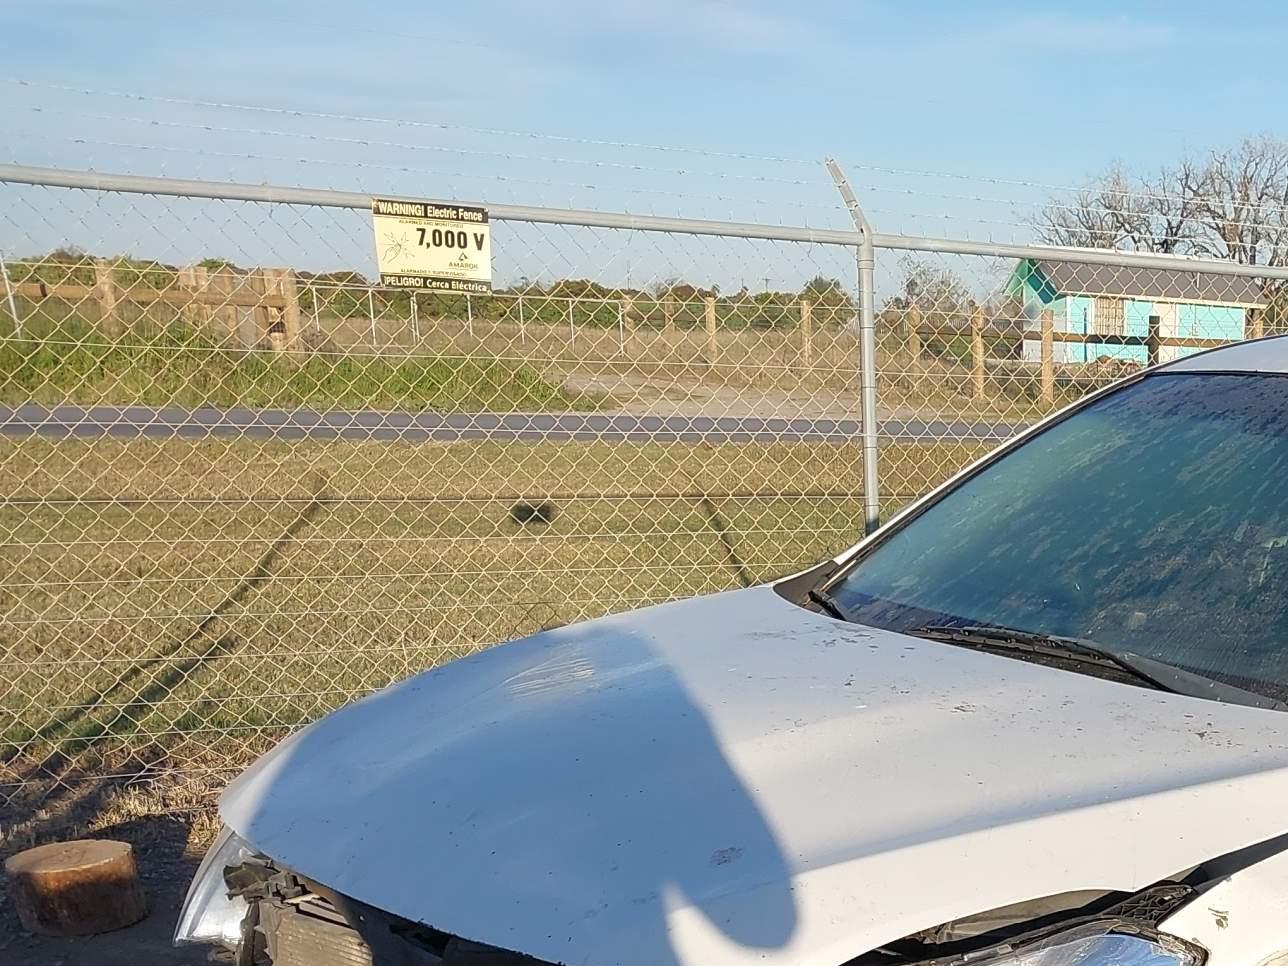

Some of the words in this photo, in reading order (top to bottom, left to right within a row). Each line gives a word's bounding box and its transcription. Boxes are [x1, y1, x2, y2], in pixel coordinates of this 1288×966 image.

[378, 201, 425, 217] WARNING!
[427, 205, 457, 218] Electric
[459, 208, 483, 221] Fence
[416, 227, 468, 249] 7,000
[473, 232, 485, 251] V
[448, 261, 479, 270] AMAROK
[384, 276, 424, 288] ¡PELIGRO!
[426, 279, 450, 289] Cerca
[451, 281, 487, 292] Eléctrica
